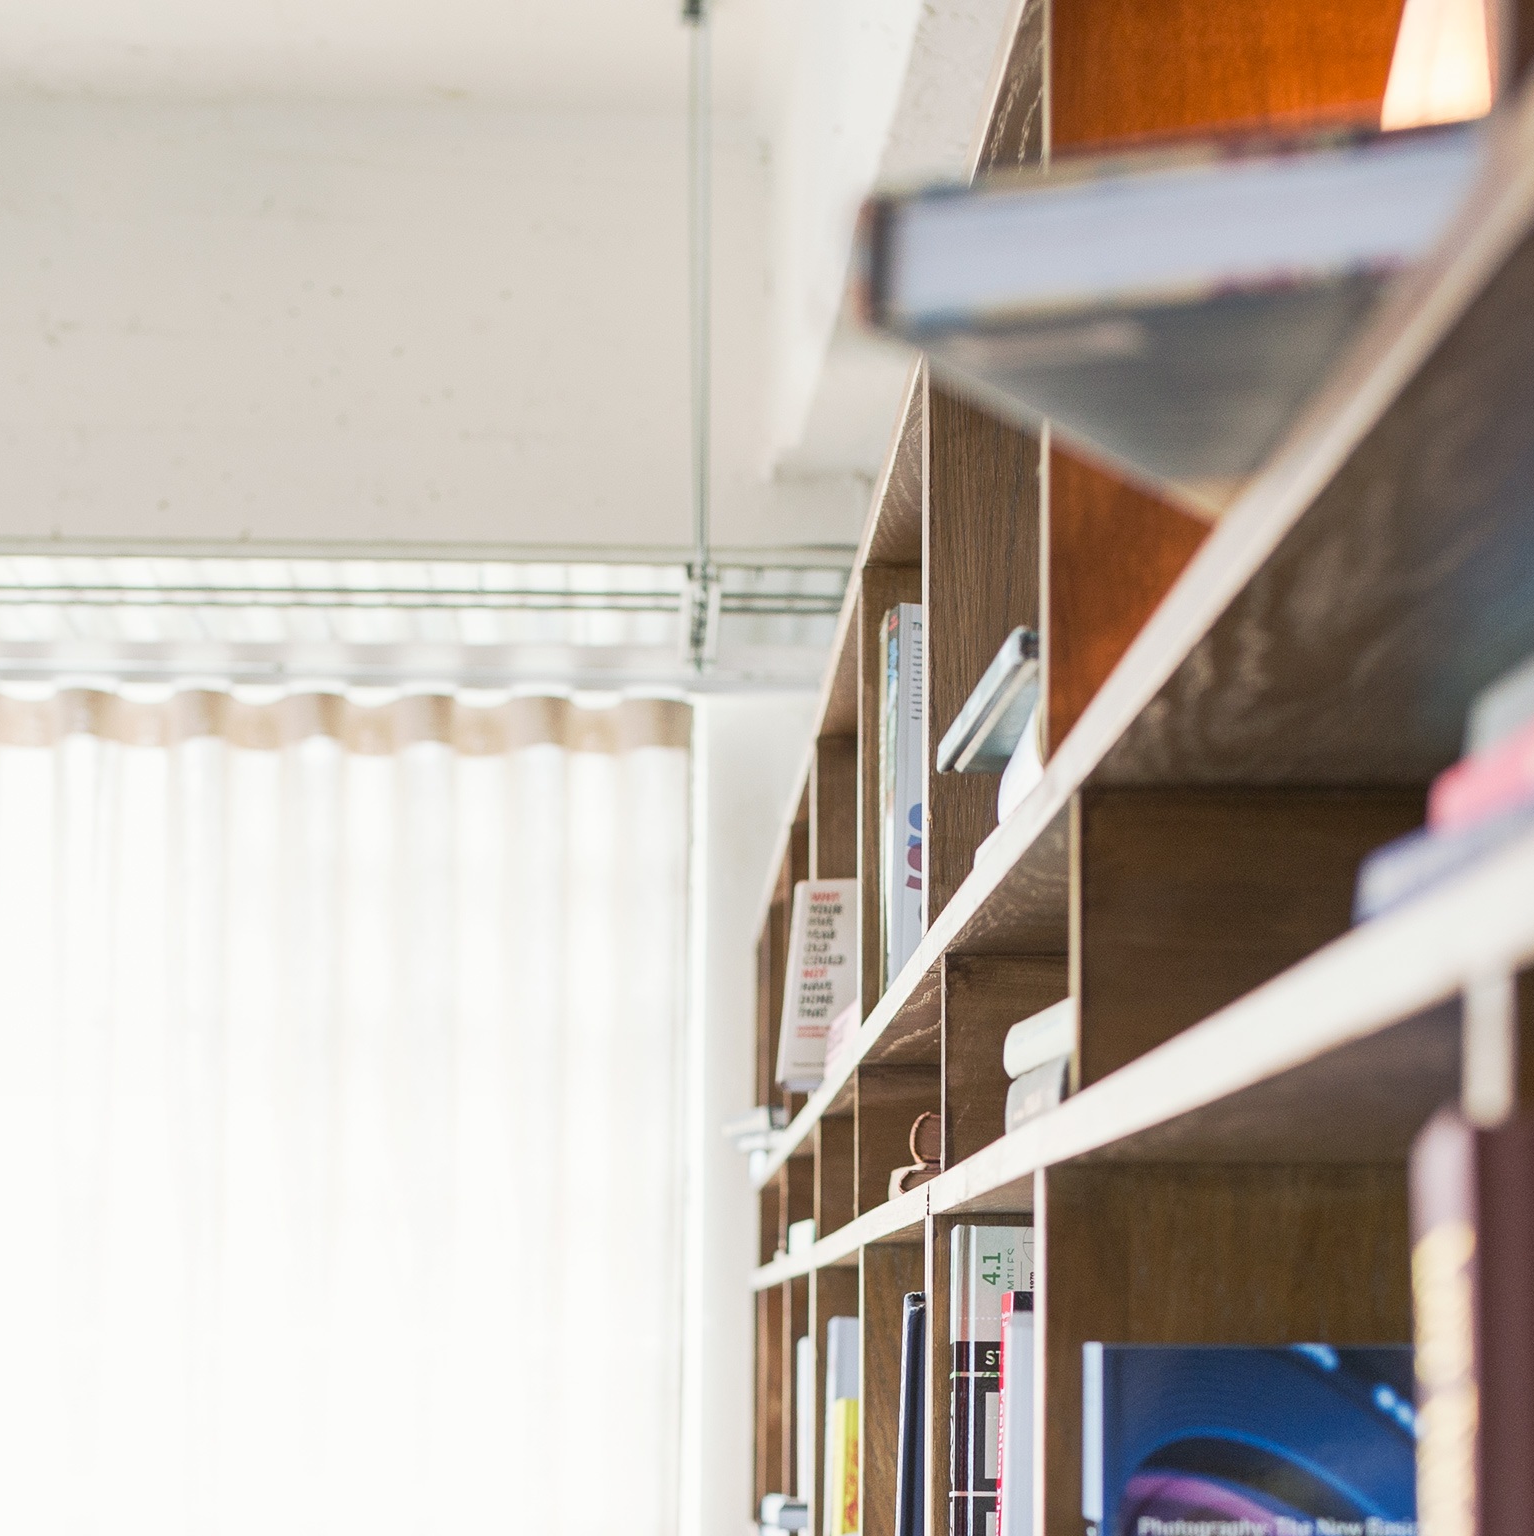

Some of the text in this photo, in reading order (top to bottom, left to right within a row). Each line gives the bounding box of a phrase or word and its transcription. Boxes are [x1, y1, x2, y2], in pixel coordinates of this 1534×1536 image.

[810, 904, 843, 914] YOUR
[802, 968, 828, 978] NOT
[982, 1252, 1002, 1286] 4.1
[997, 1388, 1005, 1479] Fashion
